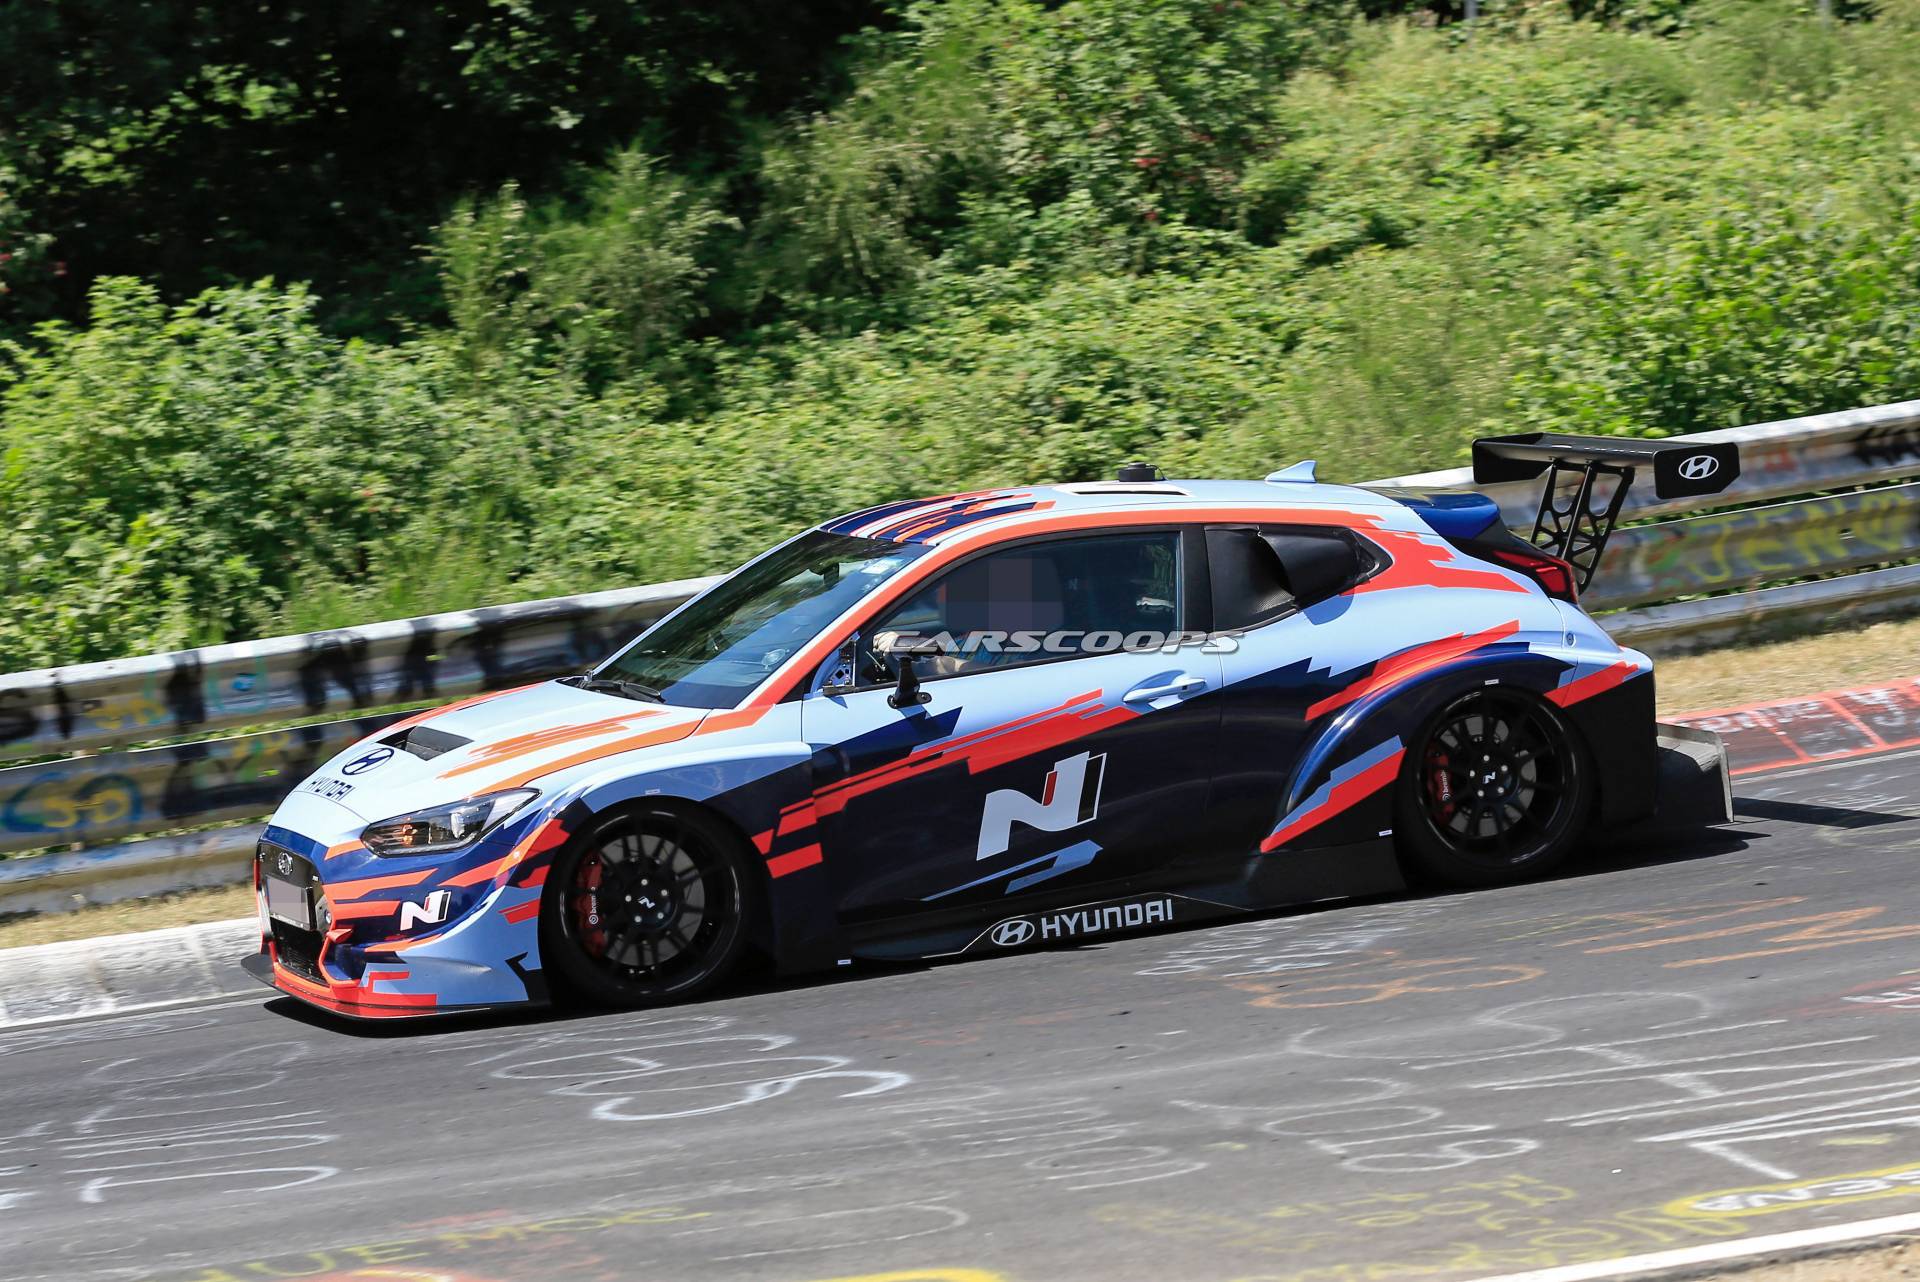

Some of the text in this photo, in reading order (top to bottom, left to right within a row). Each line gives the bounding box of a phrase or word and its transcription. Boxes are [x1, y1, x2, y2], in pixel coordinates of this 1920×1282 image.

[304, 776, 356, 801] HYUNDAI
[976, 751, 1107, 861] N
[400, 889, 451, 931] N
[1041, 899, 1174, 939] HYUNDAI
